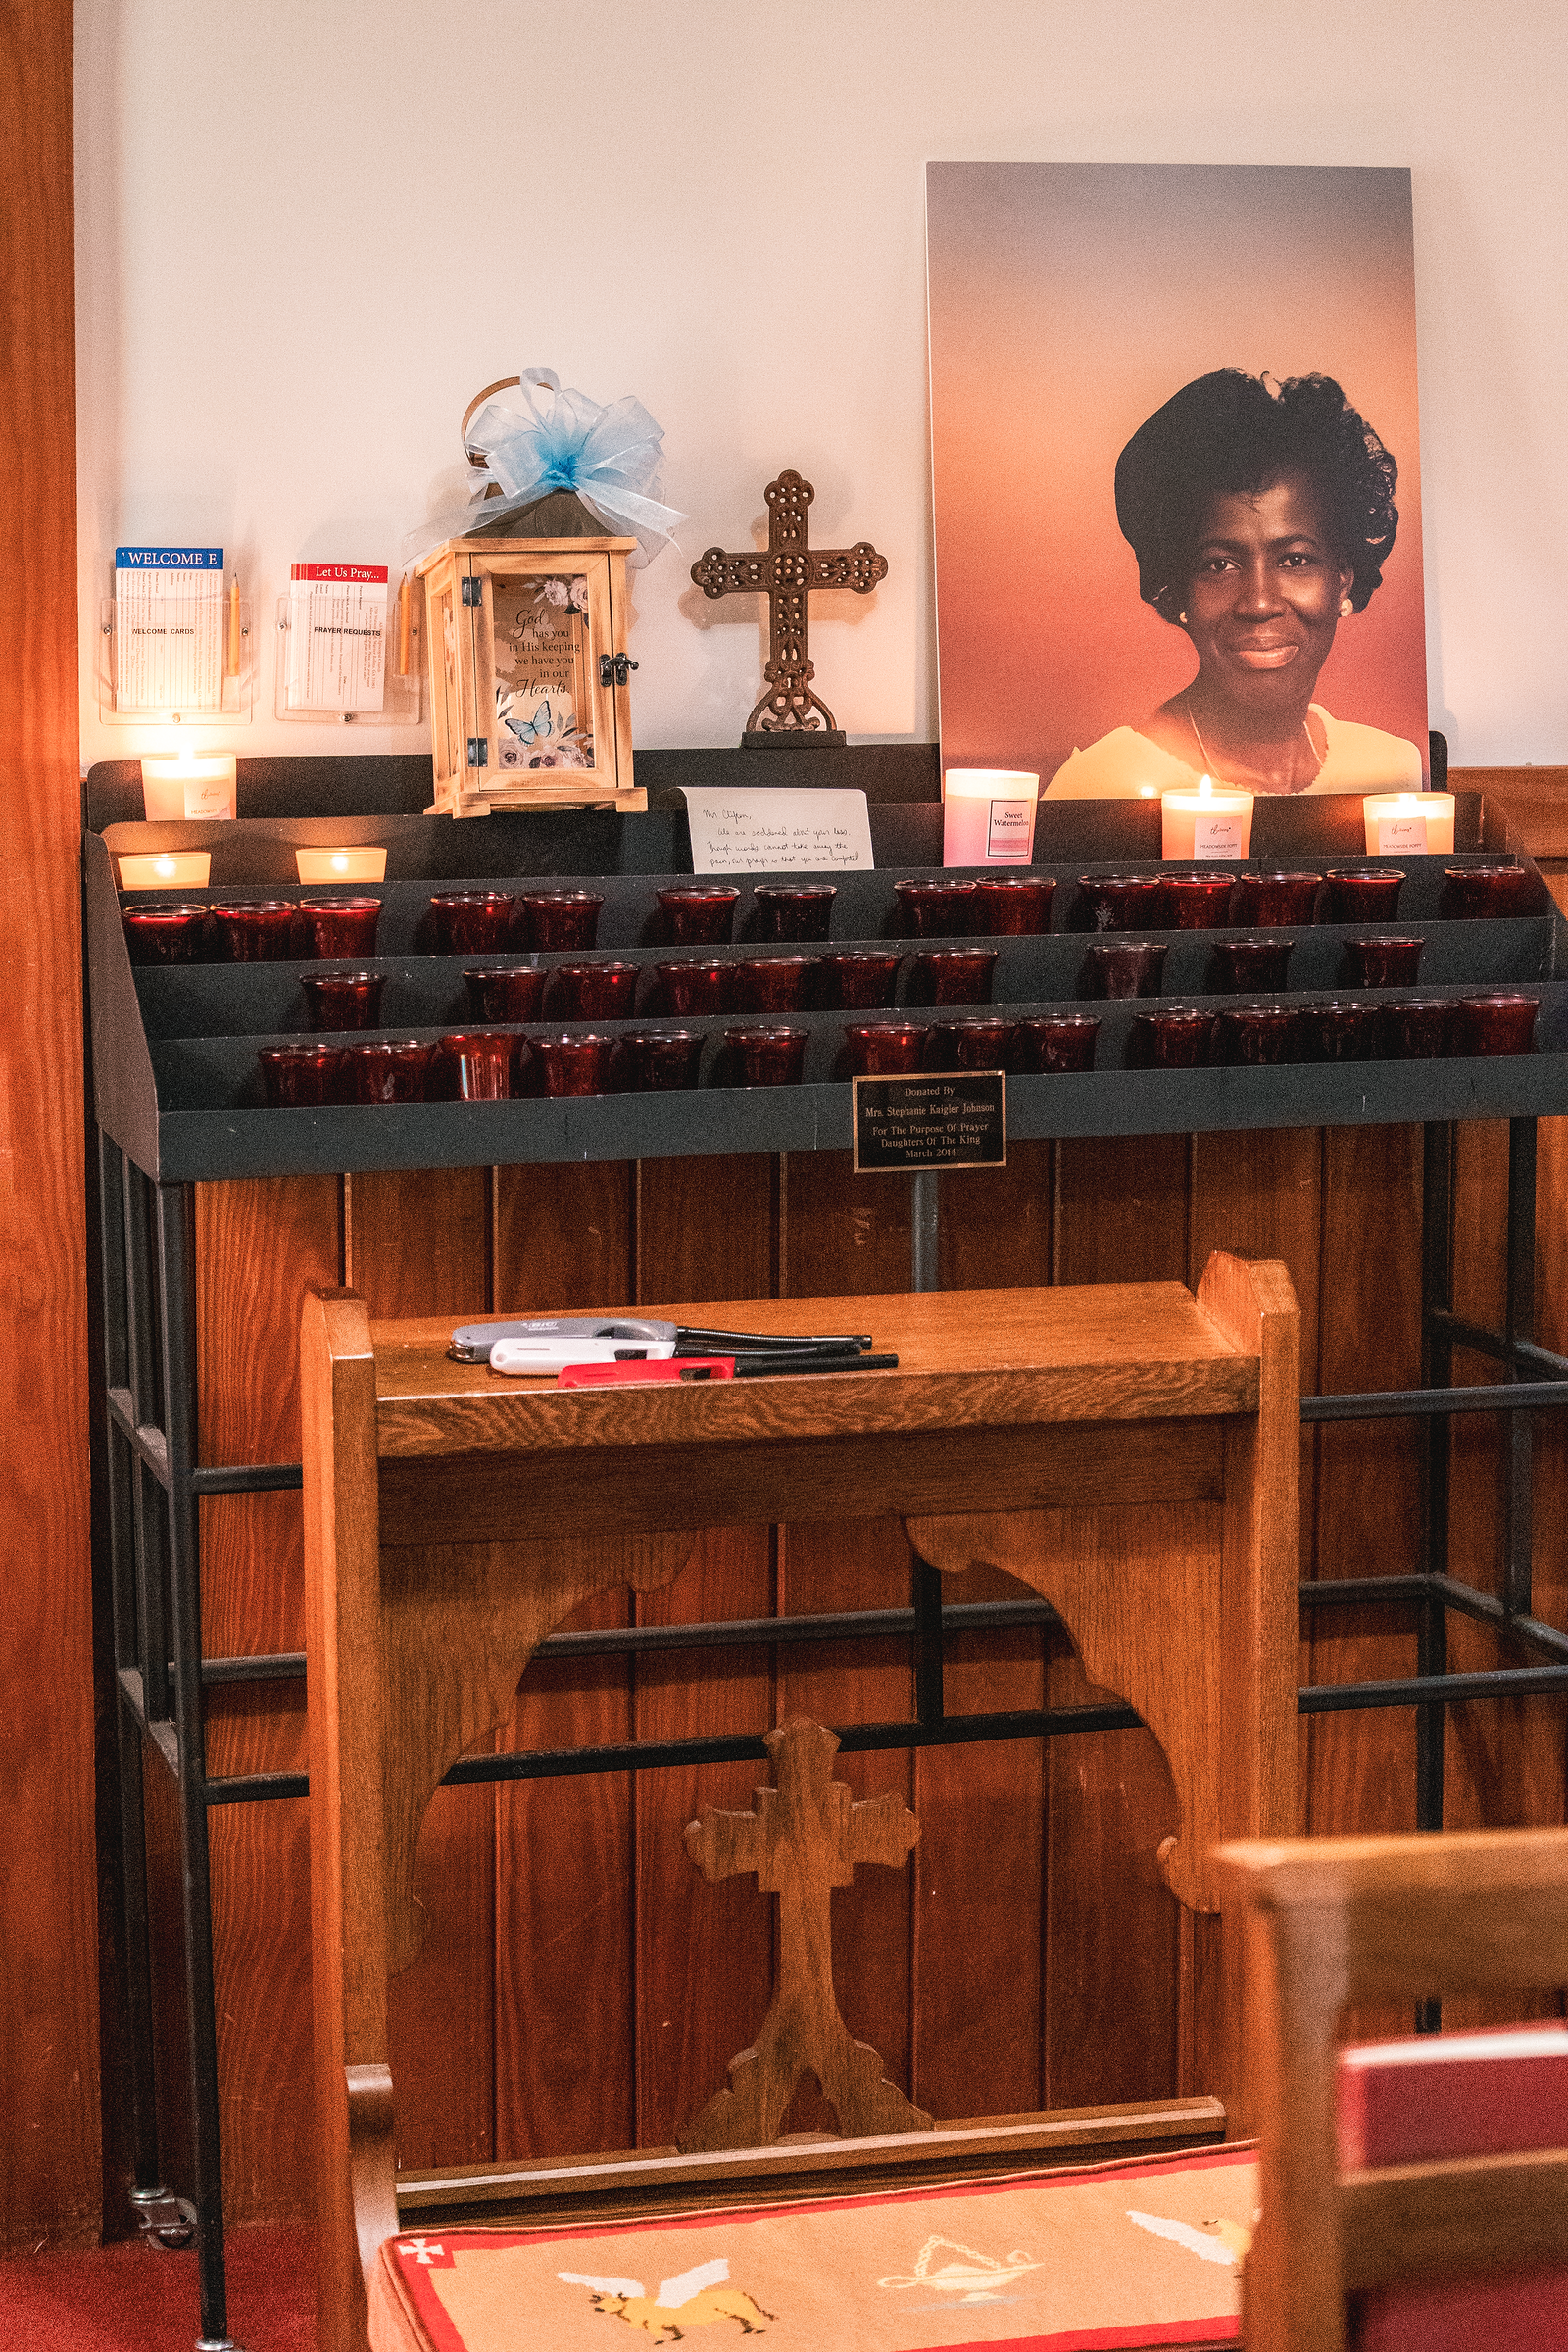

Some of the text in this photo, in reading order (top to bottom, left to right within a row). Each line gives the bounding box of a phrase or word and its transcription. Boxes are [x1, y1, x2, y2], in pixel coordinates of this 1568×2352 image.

[128, 552, 202, 564] WELCOME
[316, 567, 379, 581] Let Us Pray...
[513, 608, 545, 638] God
[343, 628, 381, 637] REQUESTS
[533, 628, 569, 640] has you
[509, 641, 581, 654] in His keeping
[532, 655, 554, 665] have
[556, 657, 574, 667] you
[540, 669, 549, 678] in
[752, 827, 787, 836] saddened
[793, 828, 810, 836] about
[813, 830, 830, 840] your
[735, 842, 758, 852] words
[813, 844, 833, 856] away
[905, 1086, 955, 1096] Donated By
[865, 1102, 994, 1118] Mrs. Stephanie Kaigler Johnson
[872, 1123, 989, 1135] For The Purpose Of Prayer
[882, 1135, 980, 1148] Daughters Of The King
[906, 1148, 956, 1158] March 2014
